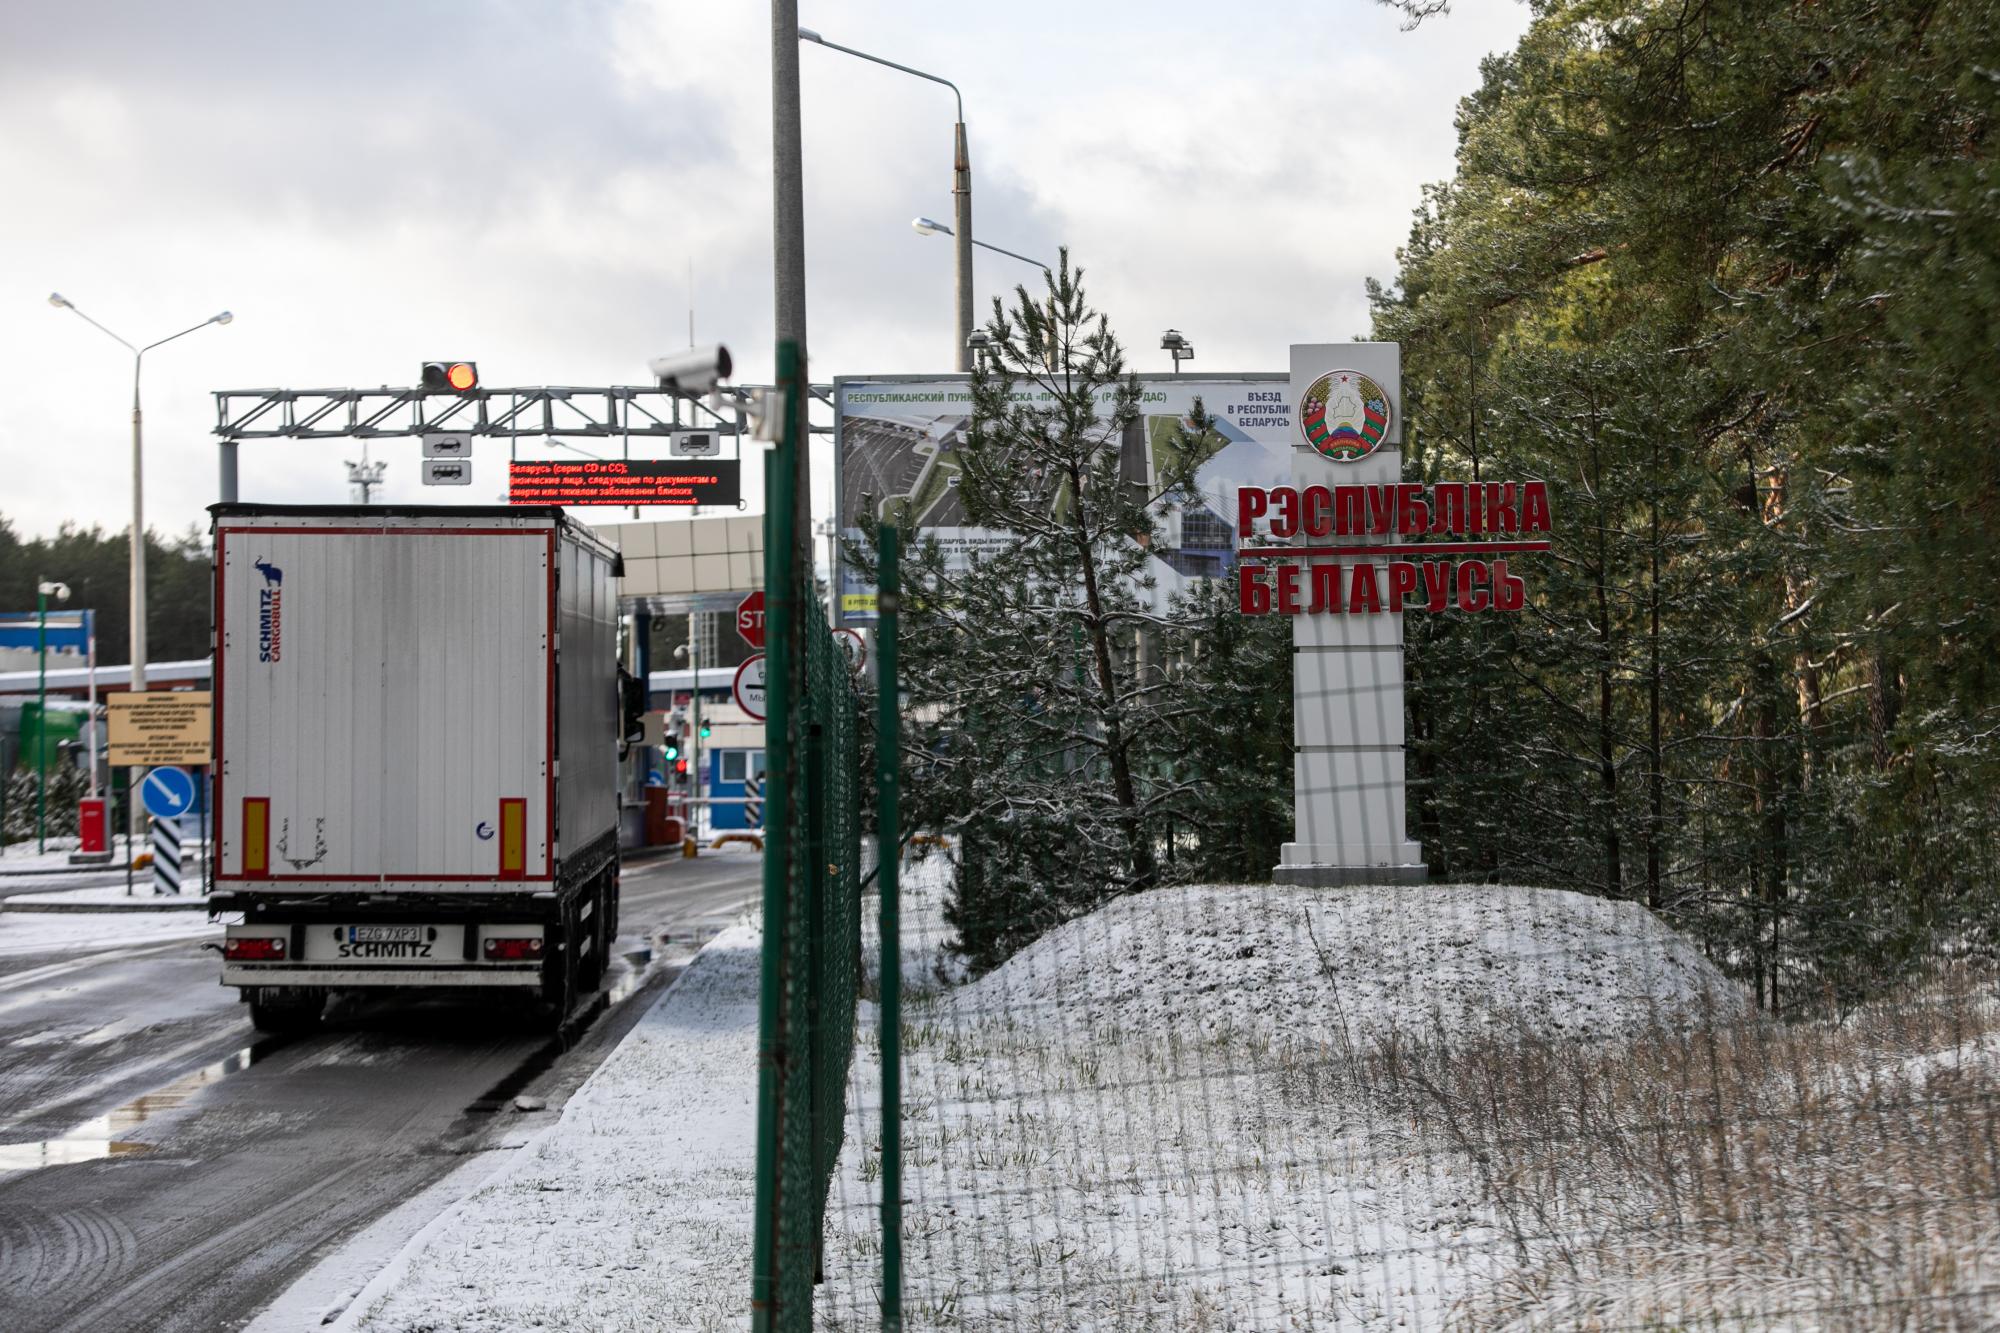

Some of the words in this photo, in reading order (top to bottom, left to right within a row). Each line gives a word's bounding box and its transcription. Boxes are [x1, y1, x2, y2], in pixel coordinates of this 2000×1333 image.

[847, 391, 945, 403] РЕСПУБЛИКАНСКИЙ
[1248, 392, 1281, 402] ВЪЕЗД
[1228, 405, 1234, 414] В
[1239, 417, 1290, 427] БЕЛАРУСЬ
[510, 464, 551, 475] Беларусь
[553, 464, 582, 475] (серии
[562, 476, 586, 486] лица,
[588, 476, 641, 486] следующие
[643, 476, 654, 484] по
[655, 476, 709, 486] документам
[510, 488, 540, 498] смерти
[542, 488, 558, 496] или
[599, 486, 656, 496] заболевании
[1238, 480, 1551, 538] РЭСПУБЛІКА
[1239, 560, 1525, 615] БЕЛАРУСЬ
[740, 610, 765, 628] ST
[260, 589, 271, 663] SCHMITZ
[271, 589, 281, 663] CARGOBULL
[338, 943, 432, 958] SCHMITZ
